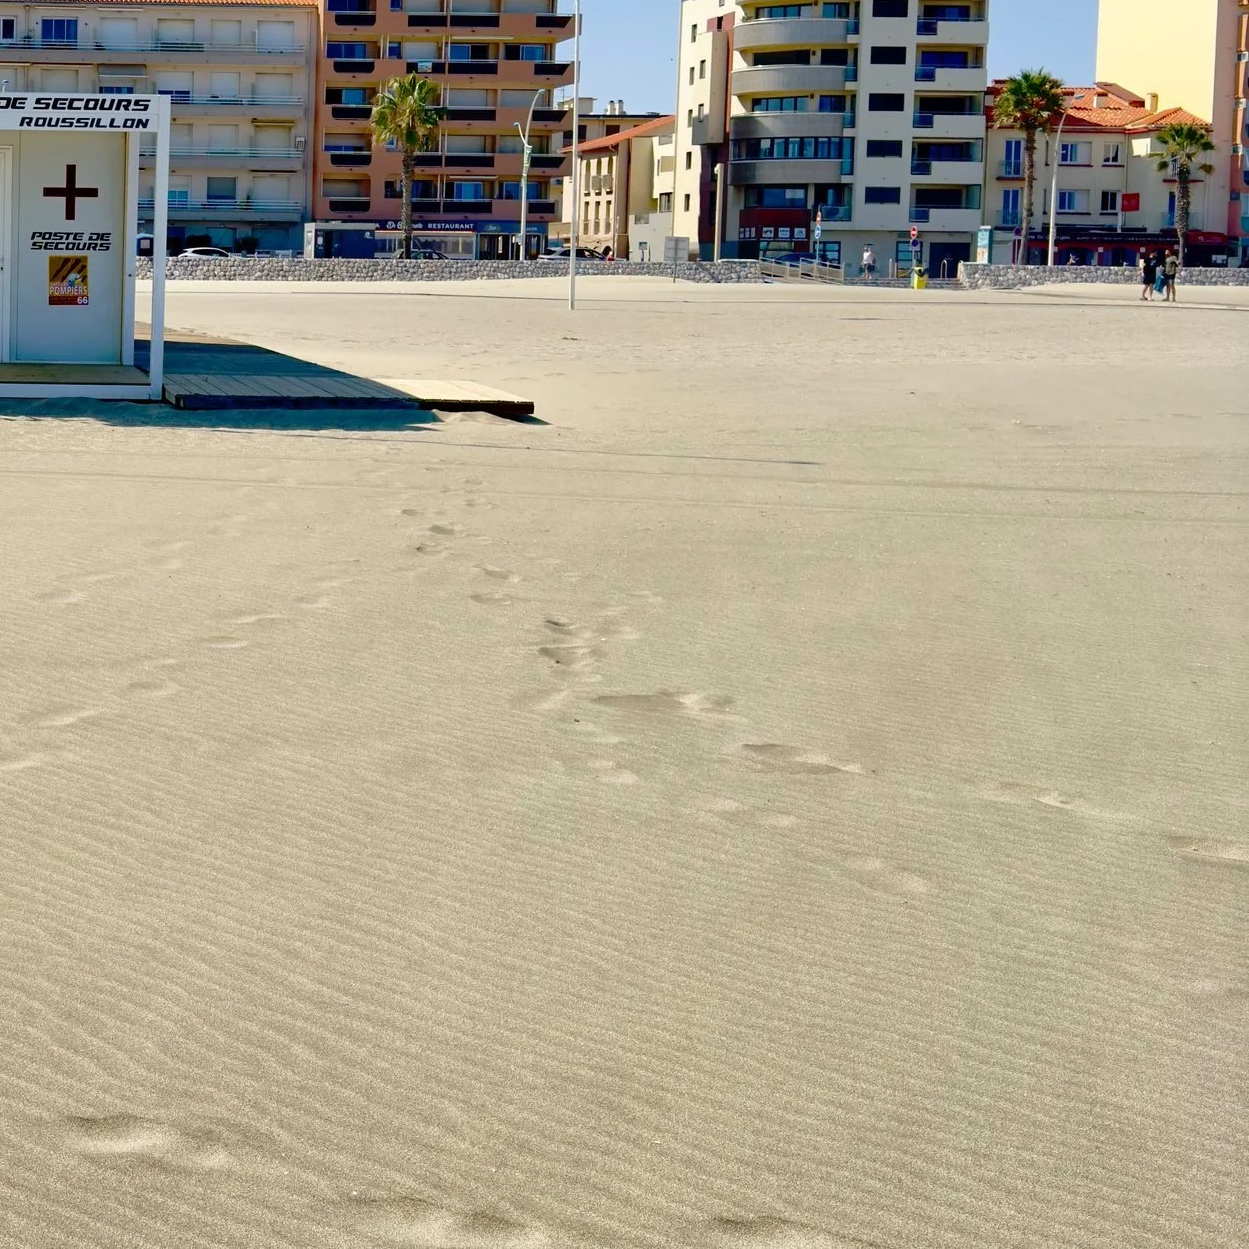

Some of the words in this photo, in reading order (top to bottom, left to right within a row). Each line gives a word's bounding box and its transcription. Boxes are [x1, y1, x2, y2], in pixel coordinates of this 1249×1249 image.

[32, 96, 151, 112] SECOURS
[19, 116, 149, 129] ROUSSILLON
[31, 232, 84, 241] POSTE
[88, 232, 112, 241] DE
[31, 242, 111, 251] SECOURS
[49, 286, 88, 295] POMPIERS
[77, 296, 88, 305] 66
